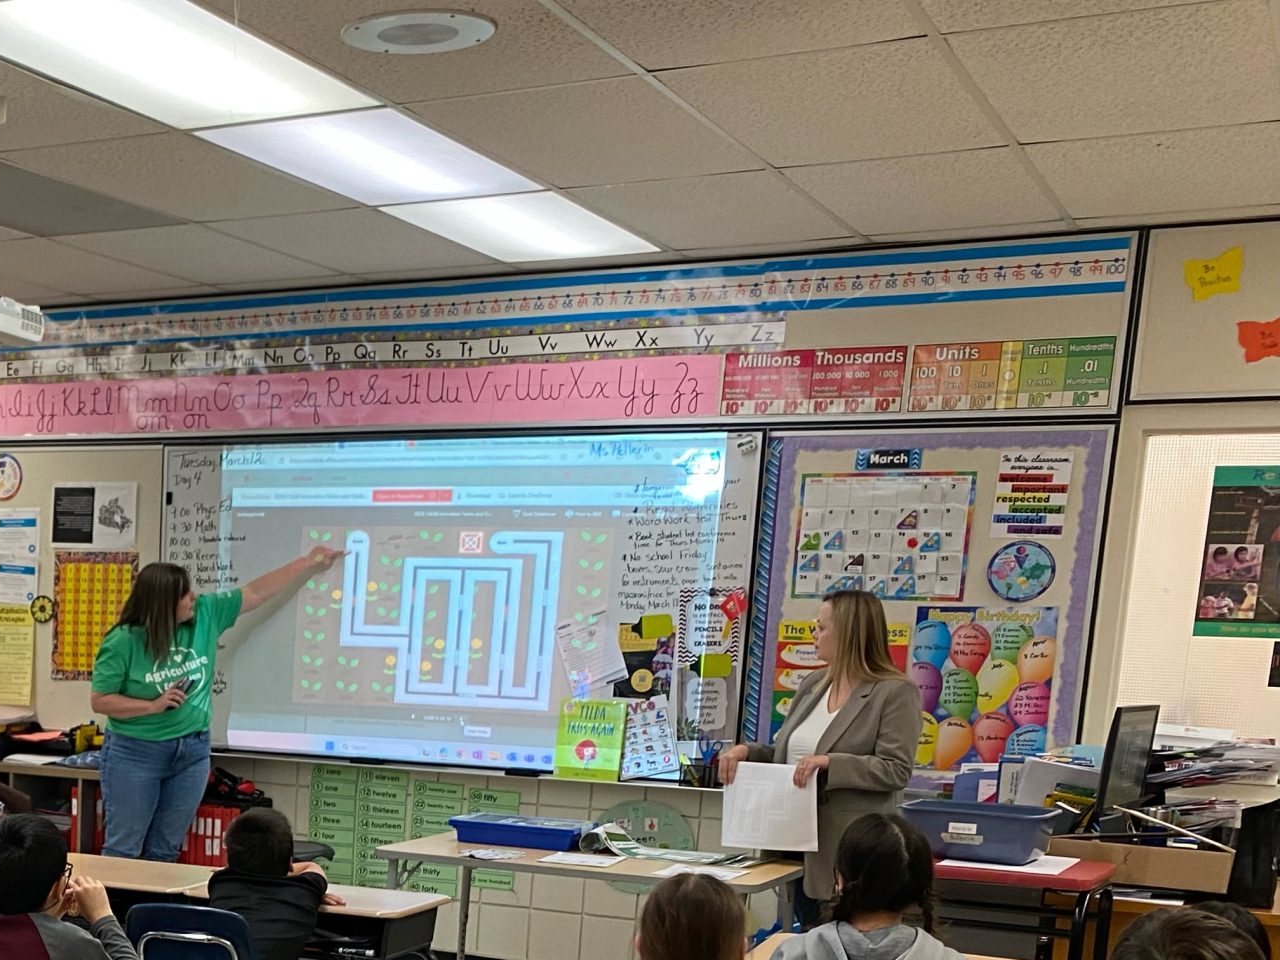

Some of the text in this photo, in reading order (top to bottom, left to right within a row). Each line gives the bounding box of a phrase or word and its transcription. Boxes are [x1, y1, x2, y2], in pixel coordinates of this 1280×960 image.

[816, 264, 1125, 292] 84 86 88 89 90 92 93 94 95 96 97 98 99 100
[7, 363, 19, 376] Ee
[141, 354, 152, 371] Jj
[171, 353, 186, 368] Kk
[264, 349, 283, 364] Nn
[294, 348, 315, 363] Oo
[325, 346, 341, 364] Pp
[354, 344, 376, 362] Qq
[393, 343, 408, 359] Rr
[425, 342, 441, 358] Ss
[459, 341, 472, 357] Tt
[489, 339, 509, 356] Uu
[538, 336, 558, 351] Vv
[585, 333, 617, 349] Ww
[634, 331, 658, 347] Xx
[694, 328, 714, 348] Yy
[751, 325, 774, 342] Zz
[1028, 344, 1063, 355] Tenths
[1070, 343, 1113, 351] Hundredths
[816, 350, 903, 365] Thousands
[936, 347, 979, 360] Units
[739, 354, 800, 368] Millions
[1081, 360, 1098, 372] .01
[916, 367, 936, 378] 100
[949, 365, 961, 377] 10
[981, 364, 987, 375] 1
[1039, 361, 1047, 374] .1
[870, 454, 908, 464] March
[1010, 465, 1044, 473] everyone
[174, 471, 202, 489] Day 4
[1012, 485, 1066, 495] important
[996, 495, 1050, 505] respected
[1012, 506, 1061, 516] accepted
[997, 515, 1042, 524] included
[195, 521, 216, 534] Math
[630, 549, 708, 562] No school Friday
[928, 609, 1040, 624] Happy Birthday!
[784, 625, 805, 635] The
[145, 655, 208, 683] Agriculture
[580, 706, 606, 720] TILDA
[375, 774, 400, 783] eleven
[372, 790, 397, 799] twelve
[484, 795, 497, 803] fifty
[372, 806, 399, 815] thirteen
[371, 821, 402, 830] fourteen
[322, 832, 335, 840] four
[423, 868, 440, 876] thirty
